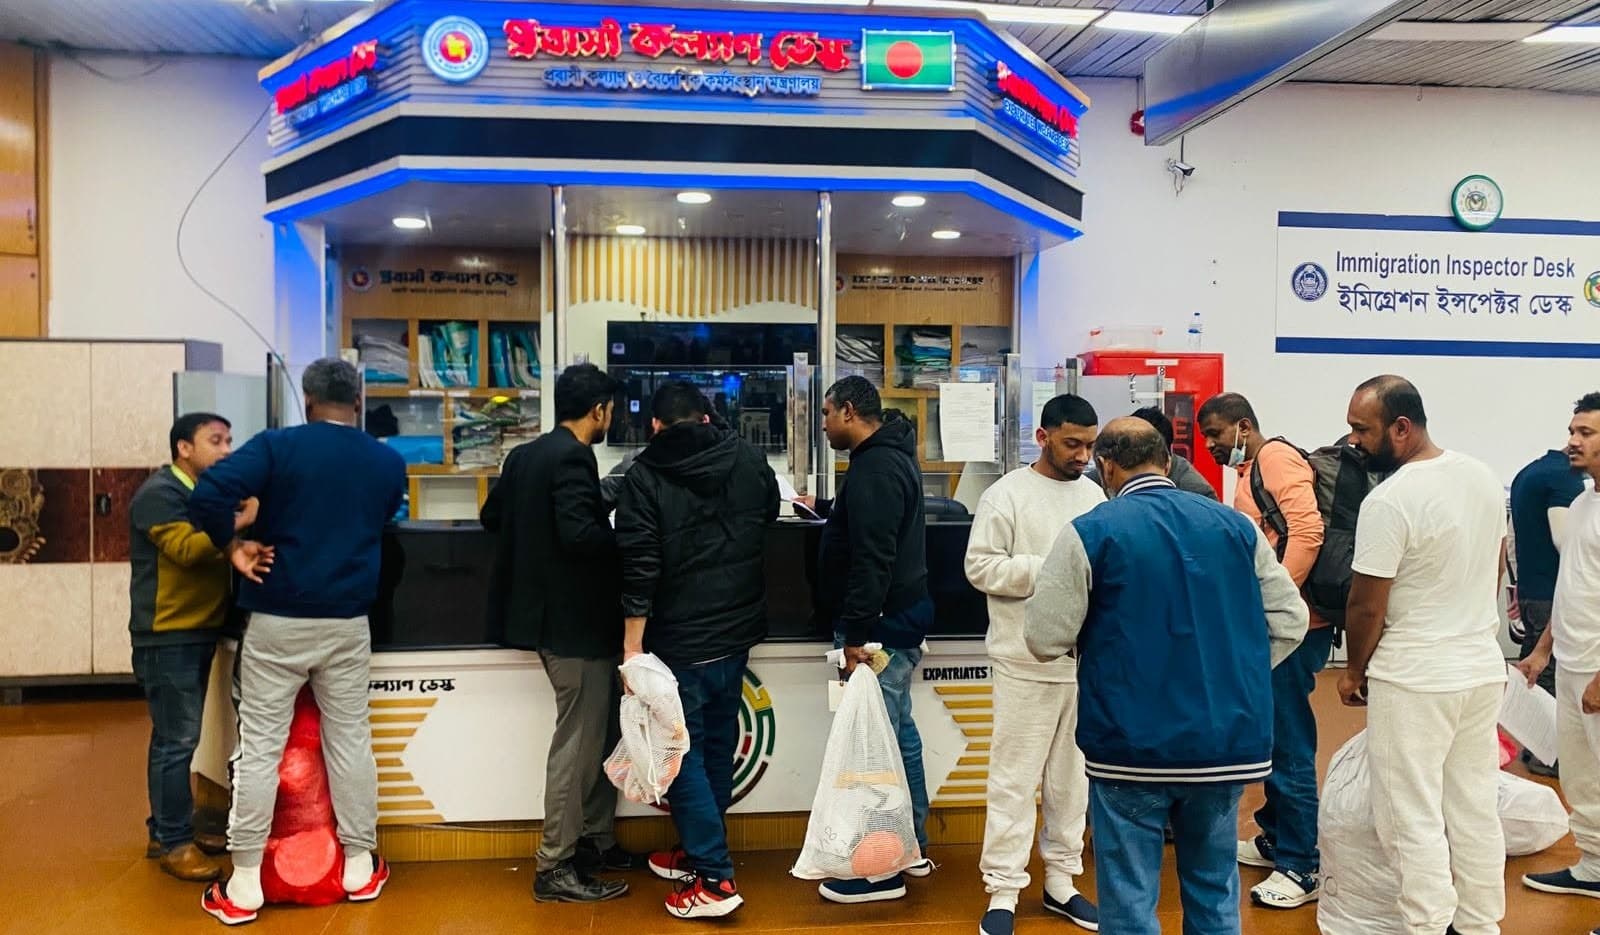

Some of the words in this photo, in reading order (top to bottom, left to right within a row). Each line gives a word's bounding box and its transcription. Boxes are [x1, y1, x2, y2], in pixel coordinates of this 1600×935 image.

[502, 17, 622, 59] প্রবাসী
[628, 22, 764, 66] কল্যাণ
[768, 30, 853, 72] ডেস্ক
[544, 65, 585, 87] প্রবাসী
[586, 69, 628, 89] কল্যাণ
[1336, 250, 1440, 279] Immigration
[1446, 254, 1528, 281] Inspector
[1533, 256, 1575, 278] Desk
[1336, 282, 1430, 314] ইমিগ্রেশন
[1434, 285, 1523, 316] ইন্সপেক্টর
[1529, 294, 1575, 317] ডেস্ক
[418, 678, 457, 693] ডেস্ক
[922, 666, 988, 681] EXPATRIATES
